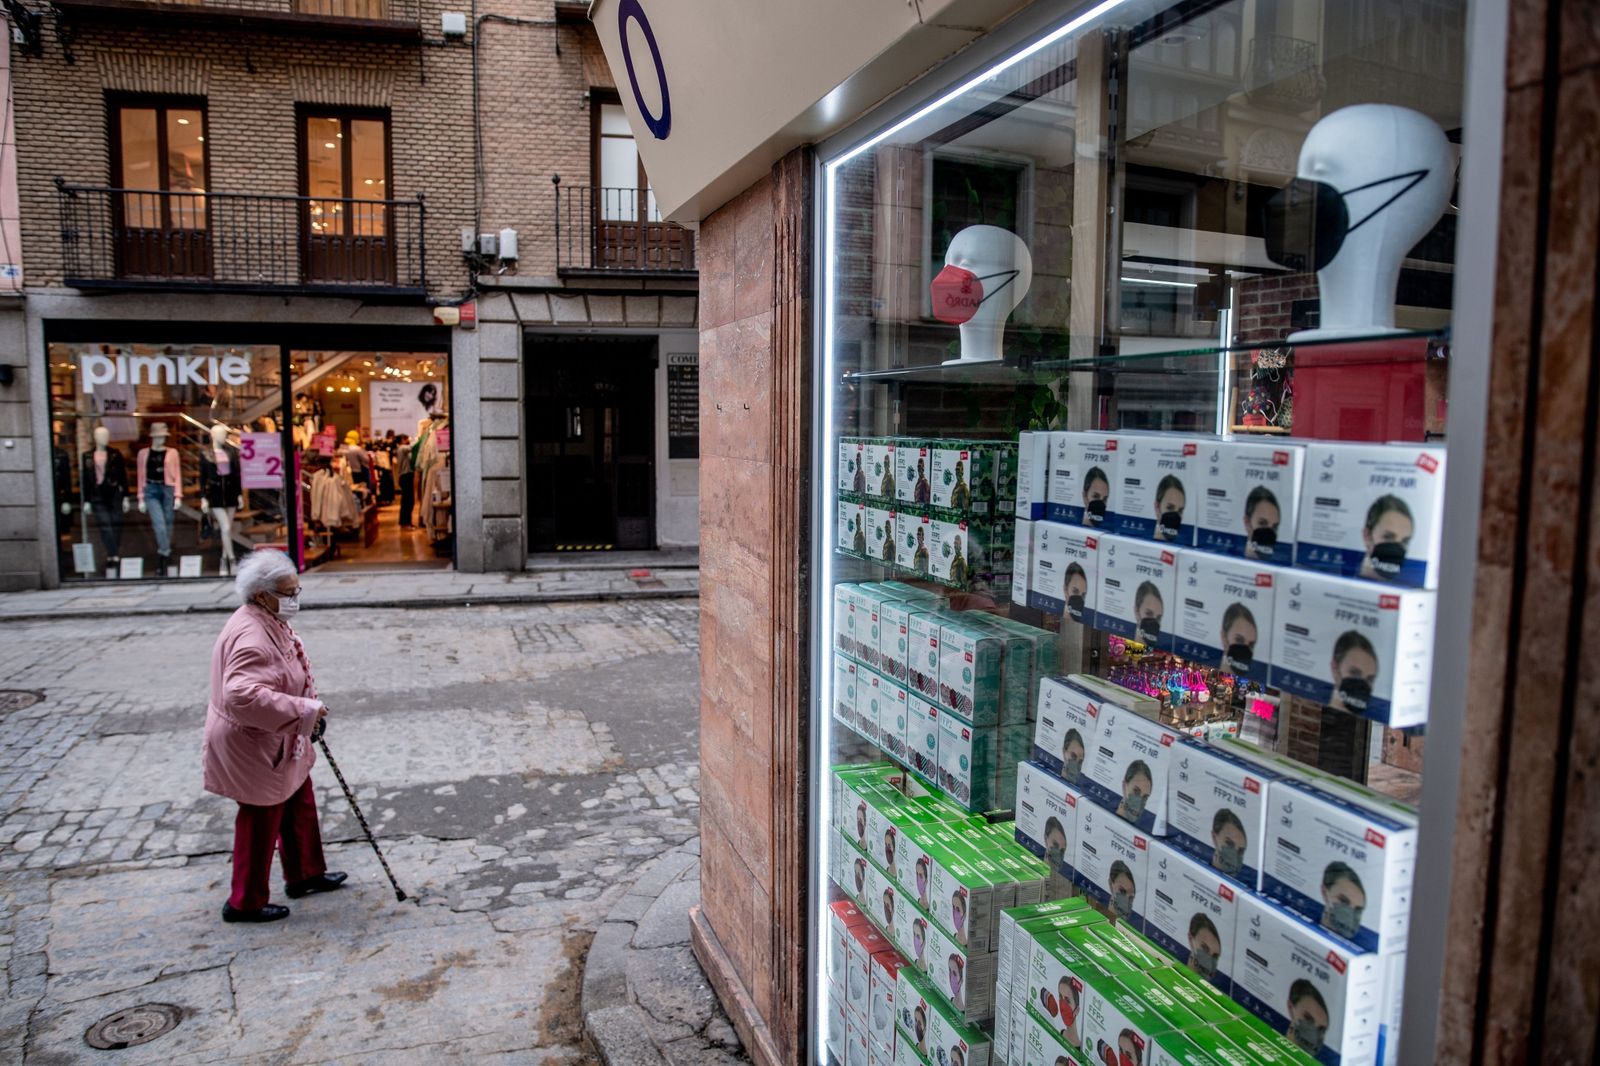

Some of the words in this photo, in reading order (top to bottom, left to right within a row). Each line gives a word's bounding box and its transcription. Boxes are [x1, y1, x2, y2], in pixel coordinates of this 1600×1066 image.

[81, 352, 252, 394] pimkie
[241, 439, 256, 460] 3
[265, 456, 282, 476] 2
[1132, 740, 1148, 754] FFP2
[1214, 786, 1232, 801] FFP2
[1046, 798, 1058, 813] FFP2
[1110, 840, 1126, 856] FFP2
[1190, 889, 1209, 909] FFP2
[1033, 958, 1047, 974] FFP2
[1088, 1004, 1105, 1024] FFP2
[1028, 1033, 1043, 1052] FFP2
